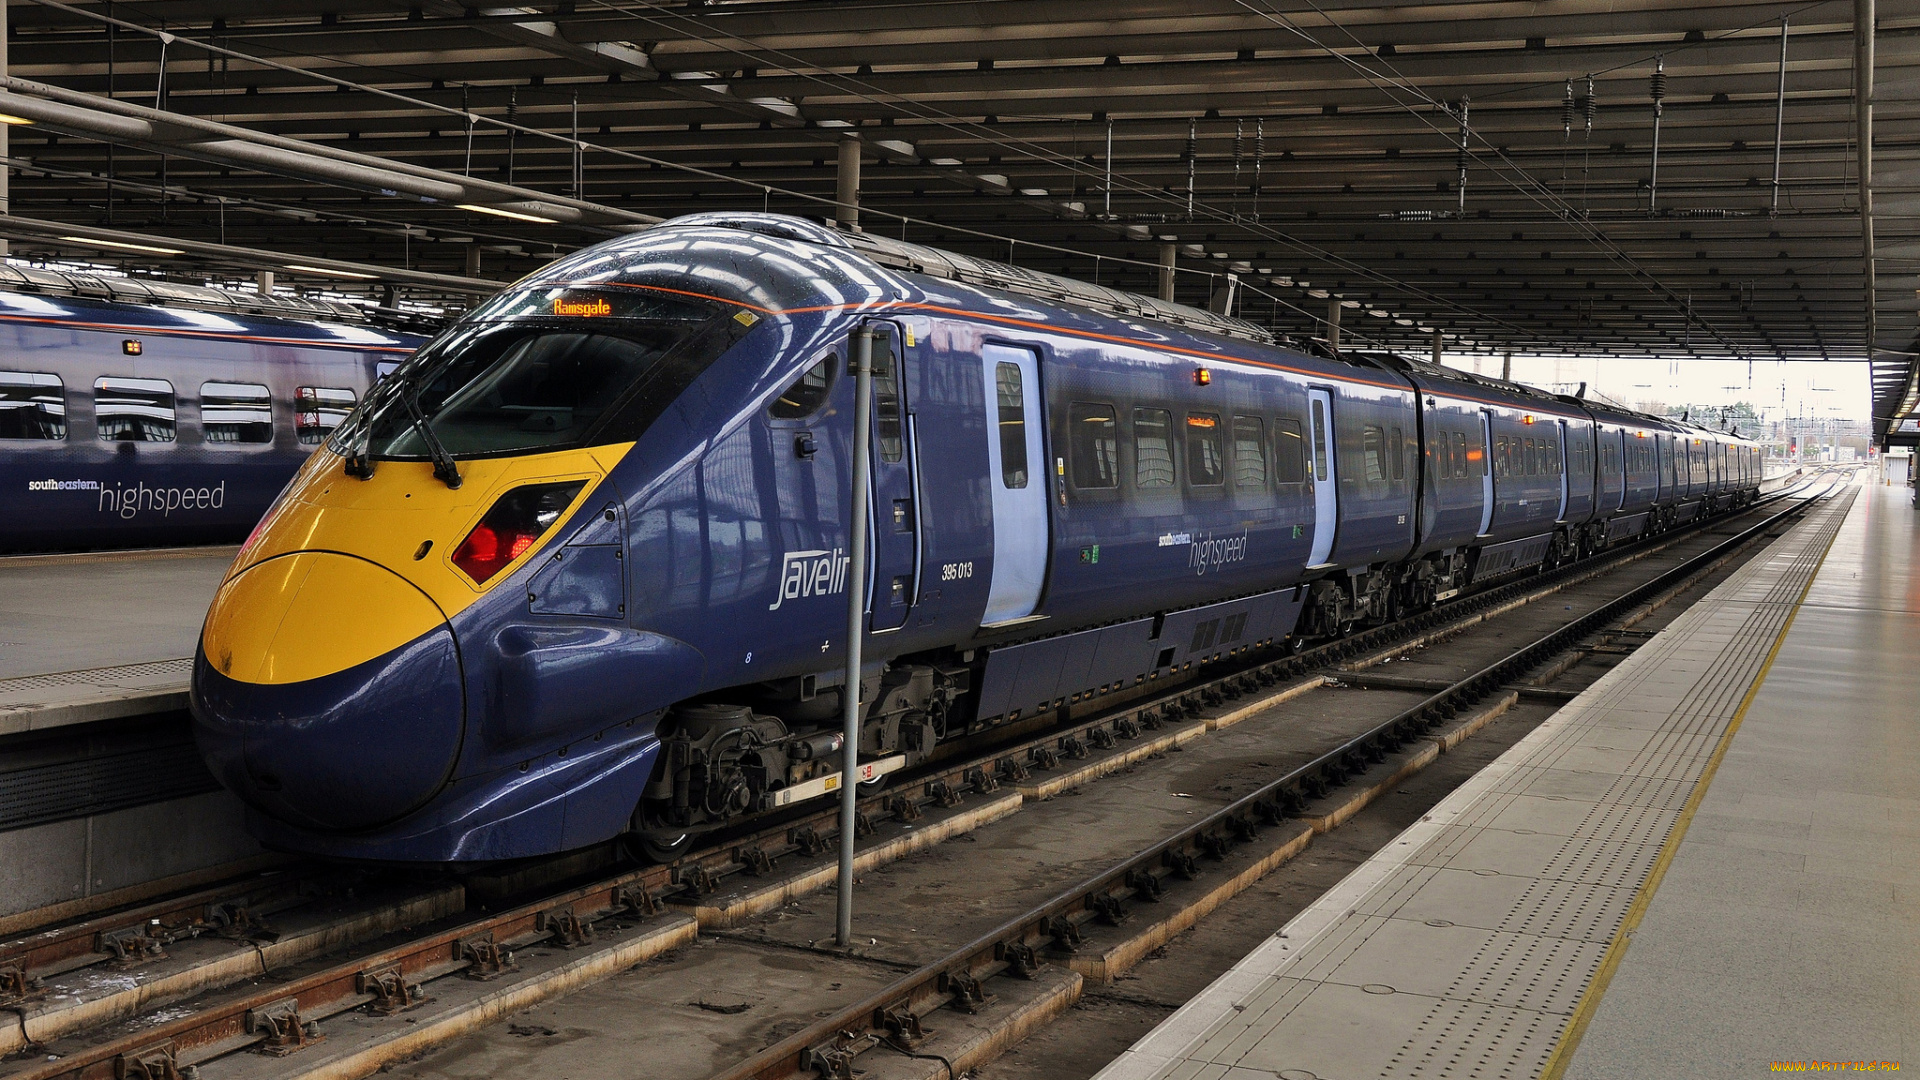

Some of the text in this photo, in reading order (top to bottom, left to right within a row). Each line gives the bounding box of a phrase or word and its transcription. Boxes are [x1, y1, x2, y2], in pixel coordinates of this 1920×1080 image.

[554, 298, 611, 317] Ramsgate
[98, 480, 225, 519] highspeed
[1189, 527, 1248, 576] highspeed
[942, 561, 973, 581] 395 013
[745, 652, 752, 664] 8
